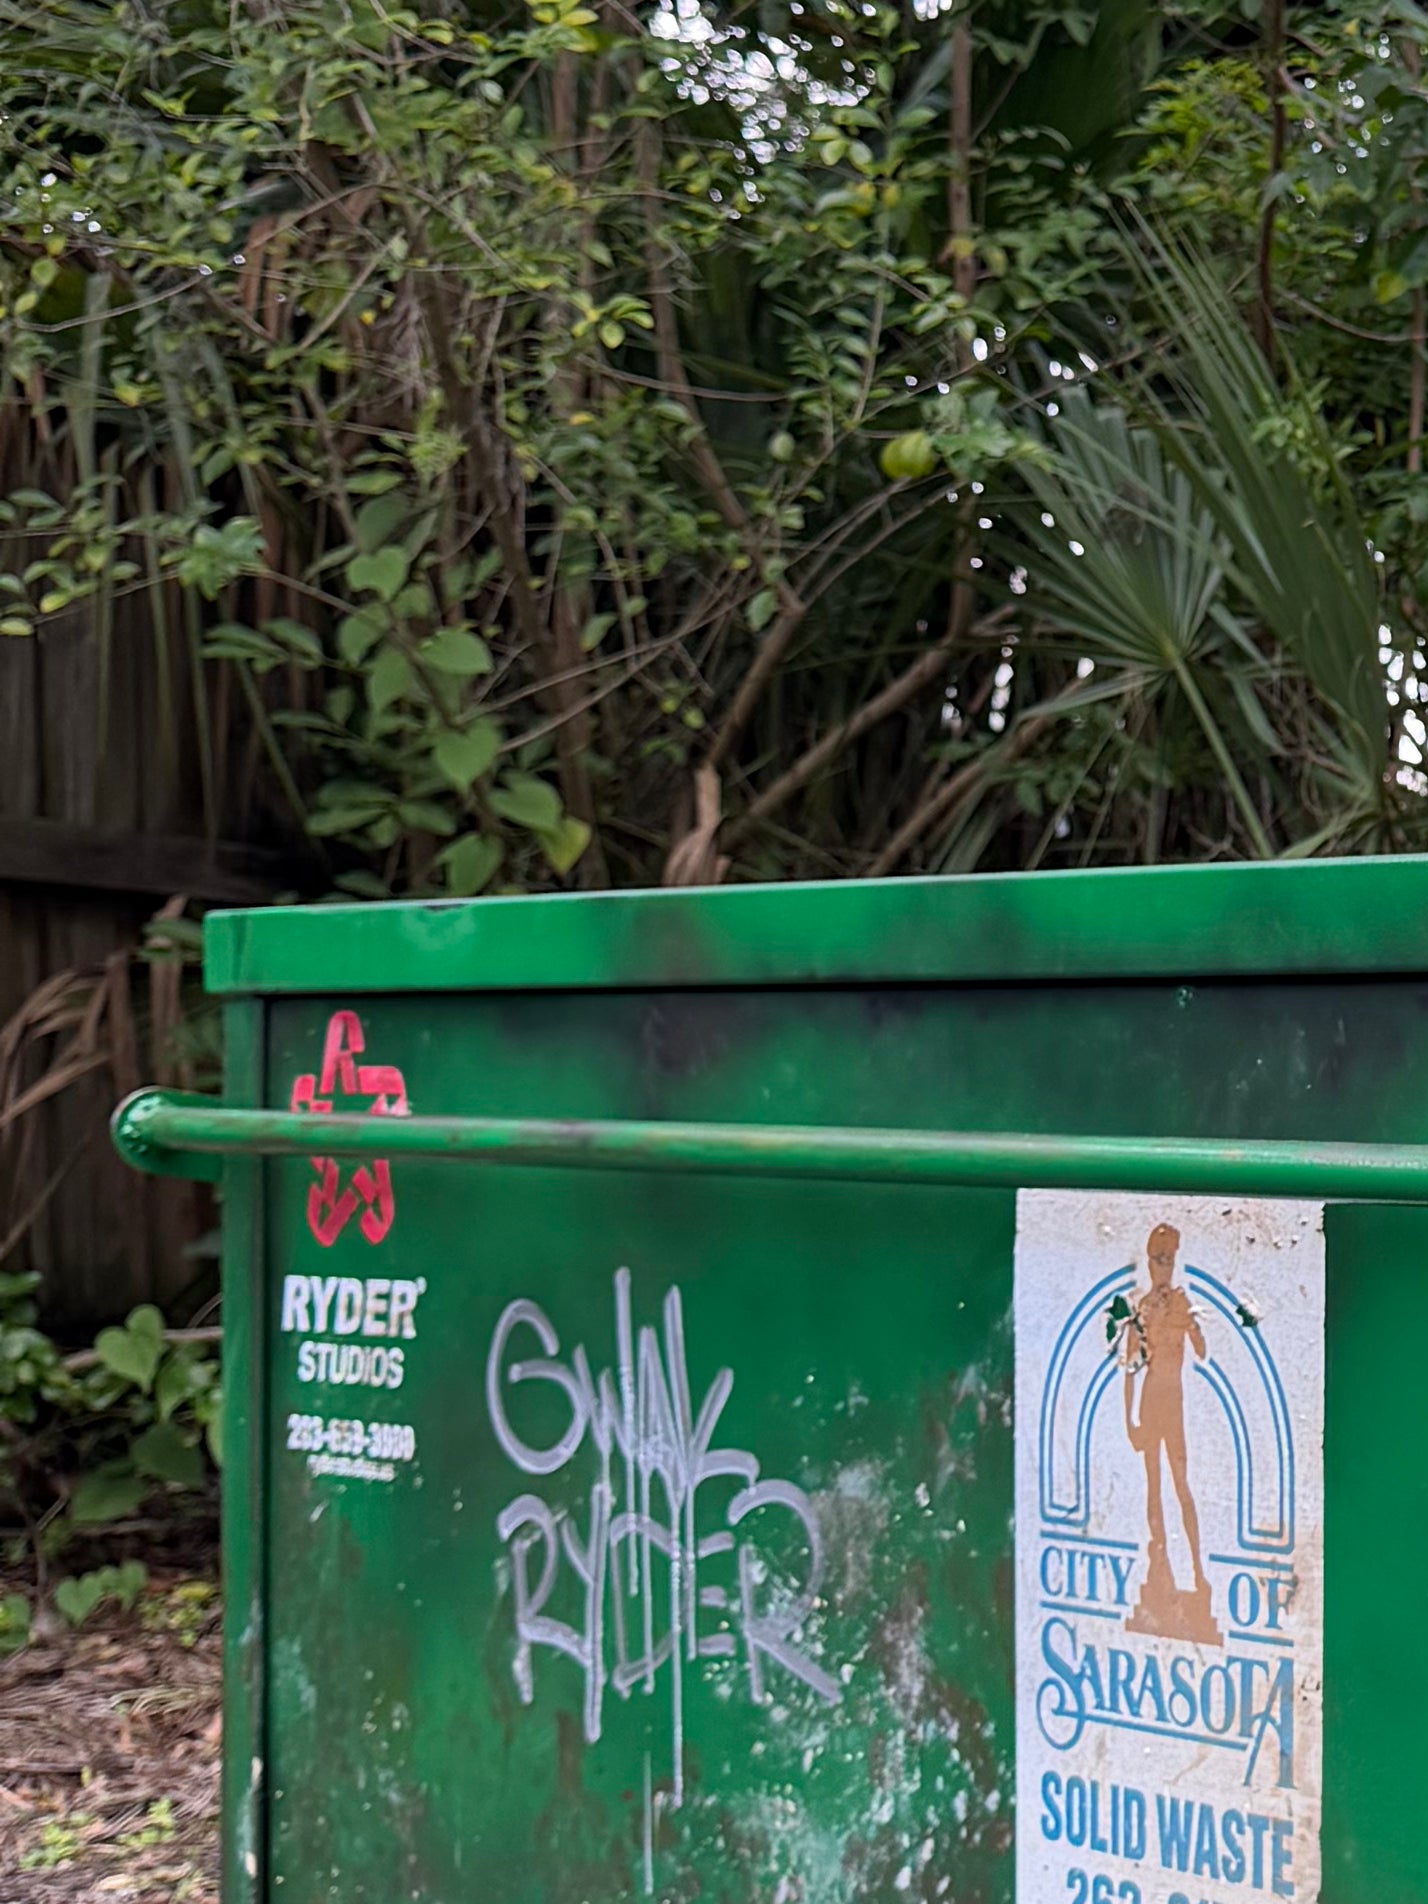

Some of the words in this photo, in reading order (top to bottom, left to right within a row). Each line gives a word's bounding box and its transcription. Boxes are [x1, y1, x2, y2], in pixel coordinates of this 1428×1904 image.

[297, 1340, 404, 1390] STUDIOS
[1040, 1545, 1136, 1606] CITY
[1228, 1571, 1294, 1630] OF
[1040, 1770, 1147, 1861] SOLID
[1155, 1793, 1295, 1896] WASTE
